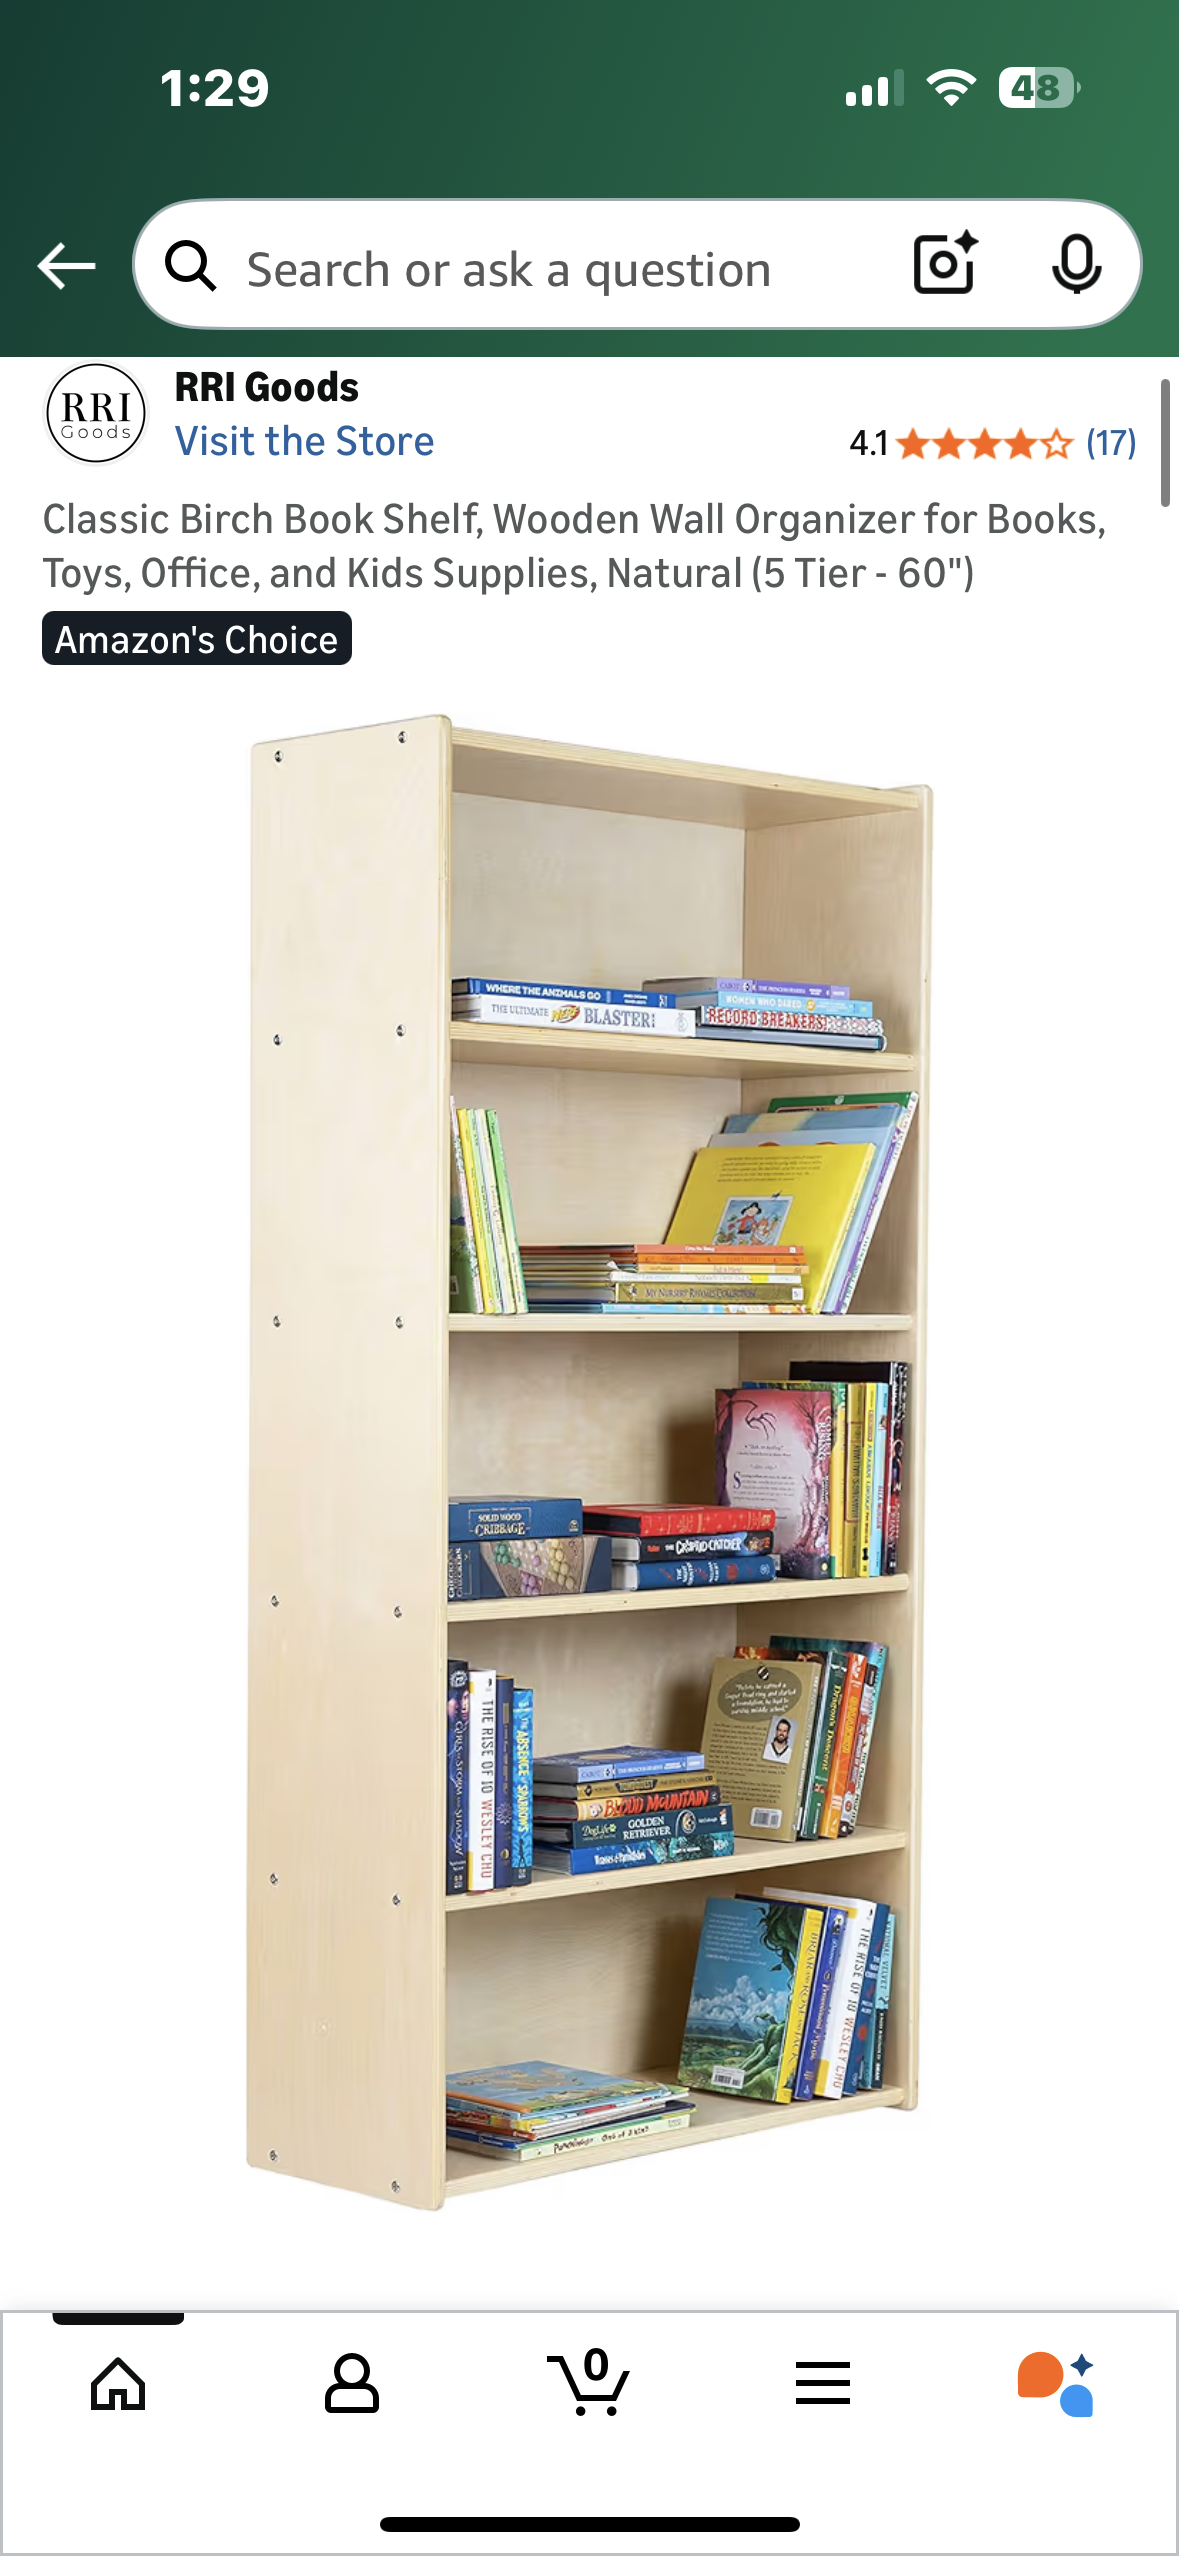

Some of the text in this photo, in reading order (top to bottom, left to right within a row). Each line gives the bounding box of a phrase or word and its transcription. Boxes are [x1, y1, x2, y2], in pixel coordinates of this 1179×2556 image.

[162, 69, 268, 107] 1:29
[1011, 74, 1060, 101] 48
[249, 250, 769, 296] Search or ask a question
[176, 370, 358, 402] RRI Goods
[61, 392, 131, 422] RRI
[61, 424, 131, 439] Goods
[175, 425, 434, 456] Visit the Store
[850, 428, 1136, 460] 4.1 (17)
[44, 502, 1105, 541] Classic Birch Book Shelf, Wooden Wall Organizer for Books,
[43, 558, 131, 595] Toys,
[142, 556, 260, 593] Office,
[271, 556, 335, 588] and
[349, 556, 422, 588] Kids
[434, 556, 597, 595] Supplies,
[609, 556, 742, 588] Natural
[753, 556, 786, 592] (5
[795, 557, 867, 588] Tier
[899, 556, 974, 592] 60")
[55, 625, 337, 654] Amazon's Choice
[486, 983, 601, 1001] WHERE THE ANIMALS GO
[725, 995, 754, 1006] WOMEN
[757, 997, 776, 1007] WHO
[491, 1004, 508, 1014] THE
[509, 1006, 548, 1017] ULTIMATE
[709, 1008, 828, 1031] RECORD BREAKERS!
[475, 1522, 526, 1537] CRIBBAGE
[478, 1512, 522, 1522] SOLID WOOD
[482, 1700, 494, 1724] THE
[822, 1684, 842, 1772] Dragon's Descent
[481, 1728, 494, 1757] RISE
[517, 1730, 529, 1776] ABSENCE
[456, 1761, 465, 1795] STORM
[481, 1761, 493, 1777] OF
[517, 1784, 529, 1832] SPARROWS
[604, 1789, 709, 1817] BLOOD MOUNTAIN
[455, 1809, 464, 1856] SHADOW
[480, 1799, 493, 1849] WESLEY
[623, 1826, 671, 1840] RETRIEVER
[628, 1816, 665, 1829] GOLDEN
[480, 1853, 493, 1879] CHU
[857, 1928, 871, 1949] THE
[852, 1951, 866, 1977] RISE
[850, 1981, 861, 1995] OF
[838, 2017, 854, 2061] WESLEY
[832, 2064, 844, 2089] CHU
[584, 2348, 608, 2381] 0
